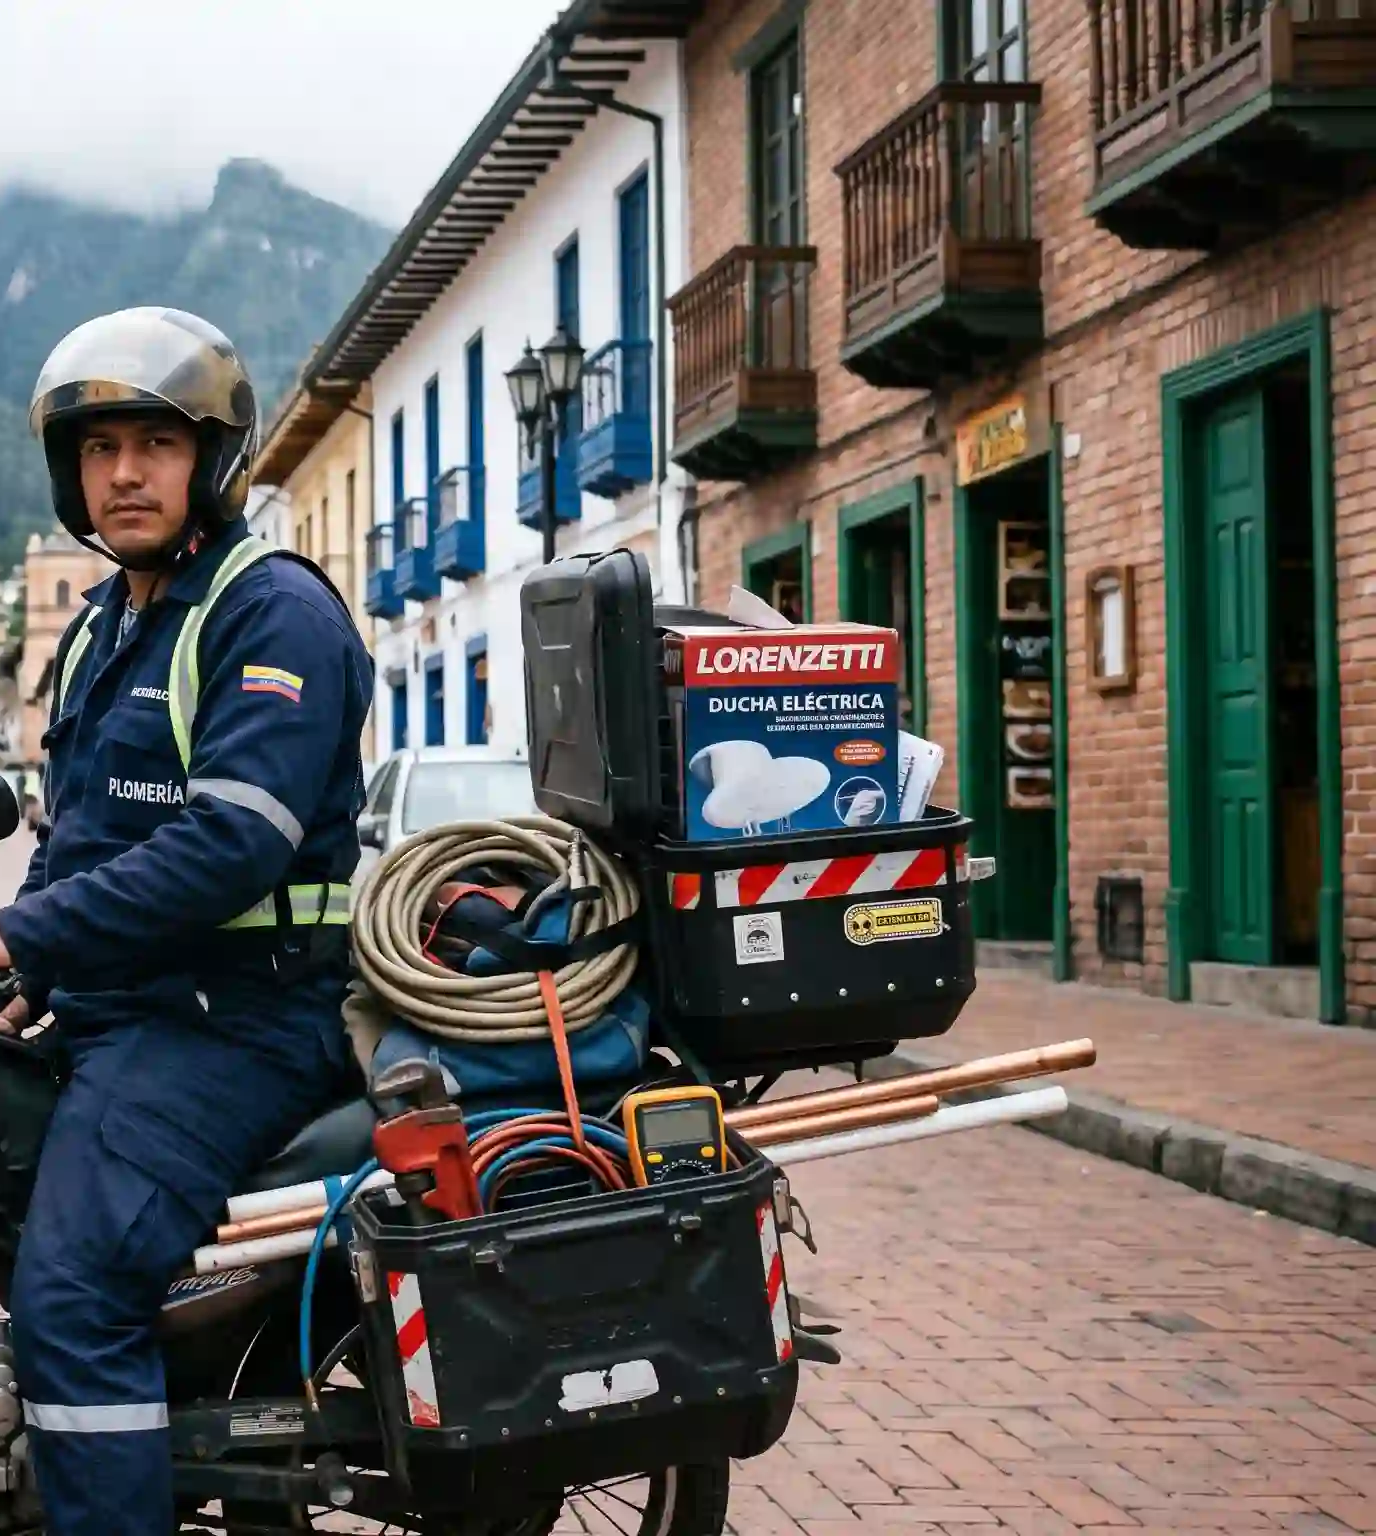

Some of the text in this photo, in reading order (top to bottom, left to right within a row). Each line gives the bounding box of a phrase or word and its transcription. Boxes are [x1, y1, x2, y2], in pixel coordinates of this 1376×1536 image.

[696, 643, 885, 674] LORENZETTI
[709, 692, 885, 713] DUCHA ELÉCTRICA
[108, 776, 185, 805] PLOMERÍA
